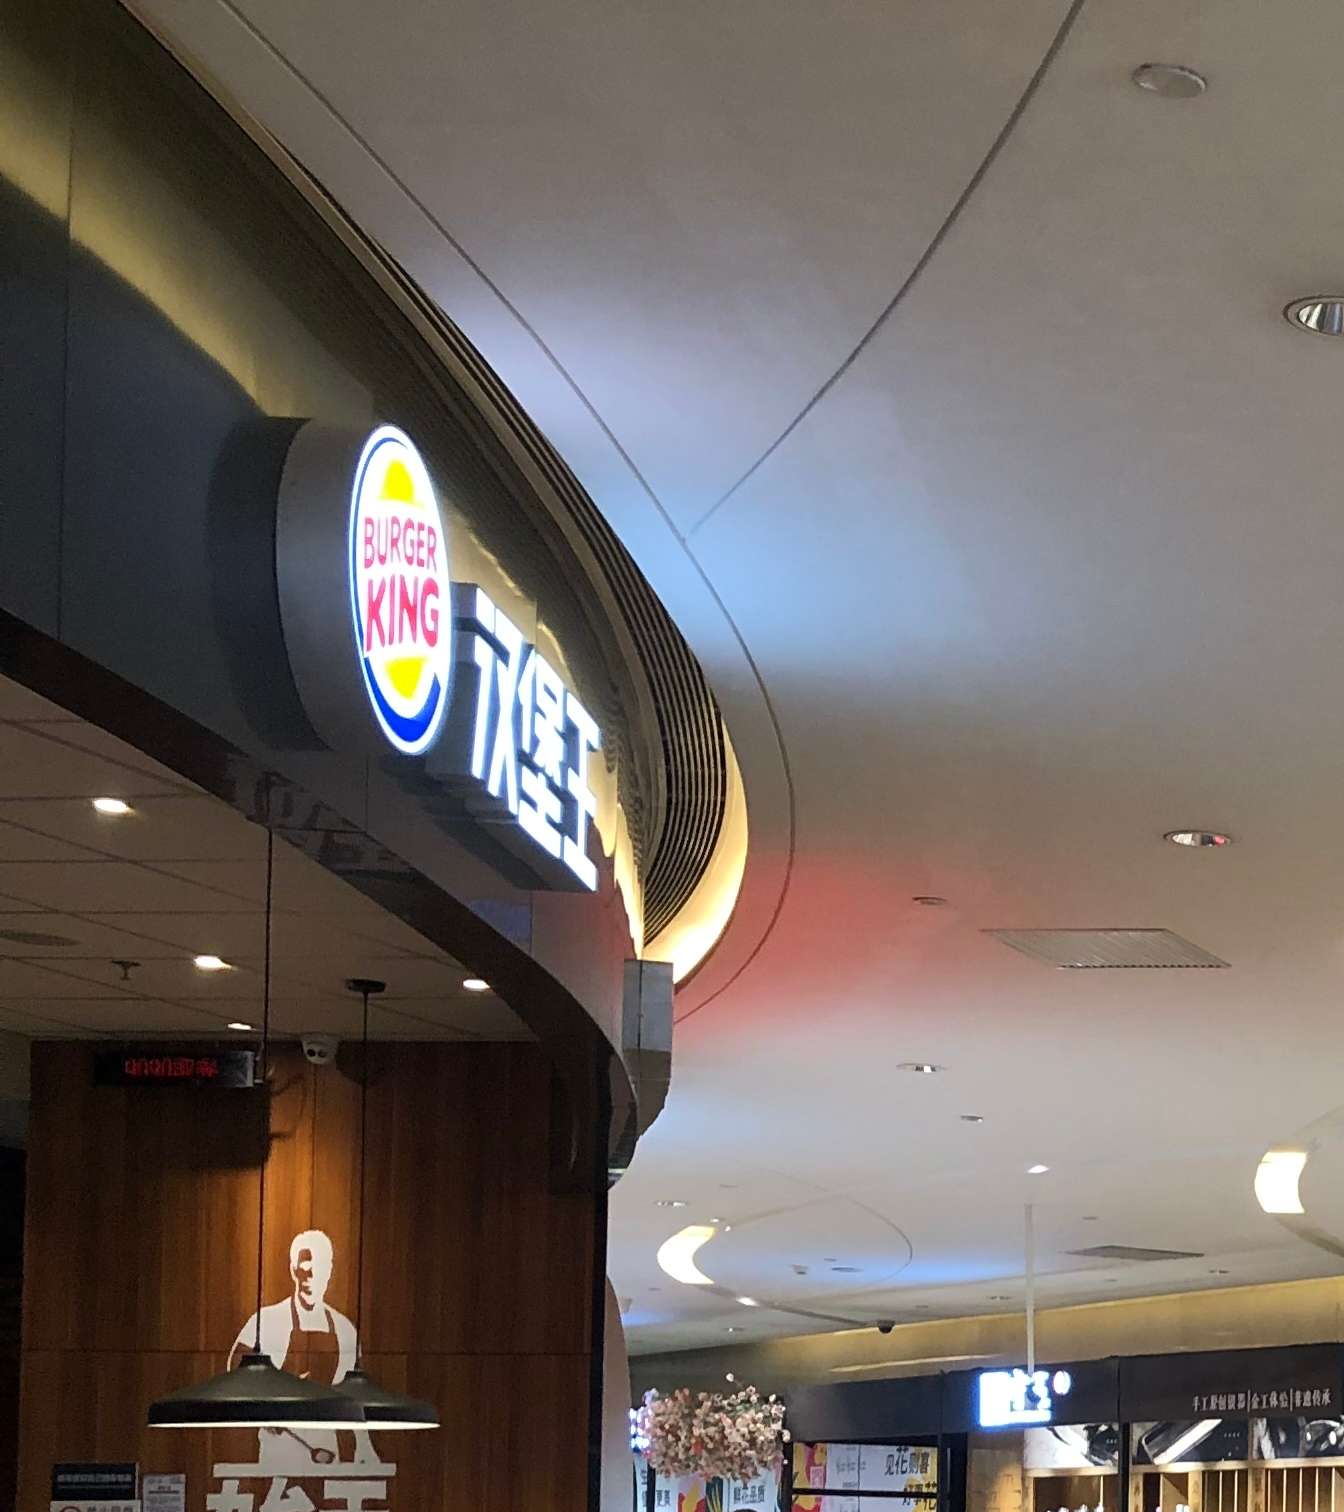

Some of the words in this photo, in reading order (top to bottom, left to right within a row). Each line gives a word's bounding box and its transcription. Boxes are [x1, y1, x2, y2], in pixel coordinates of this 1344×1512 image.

[363, 515, 438, 573] BURGER
[365, 576, 440, 654] KING
[470, 586, 601, 892] 汉堡王
